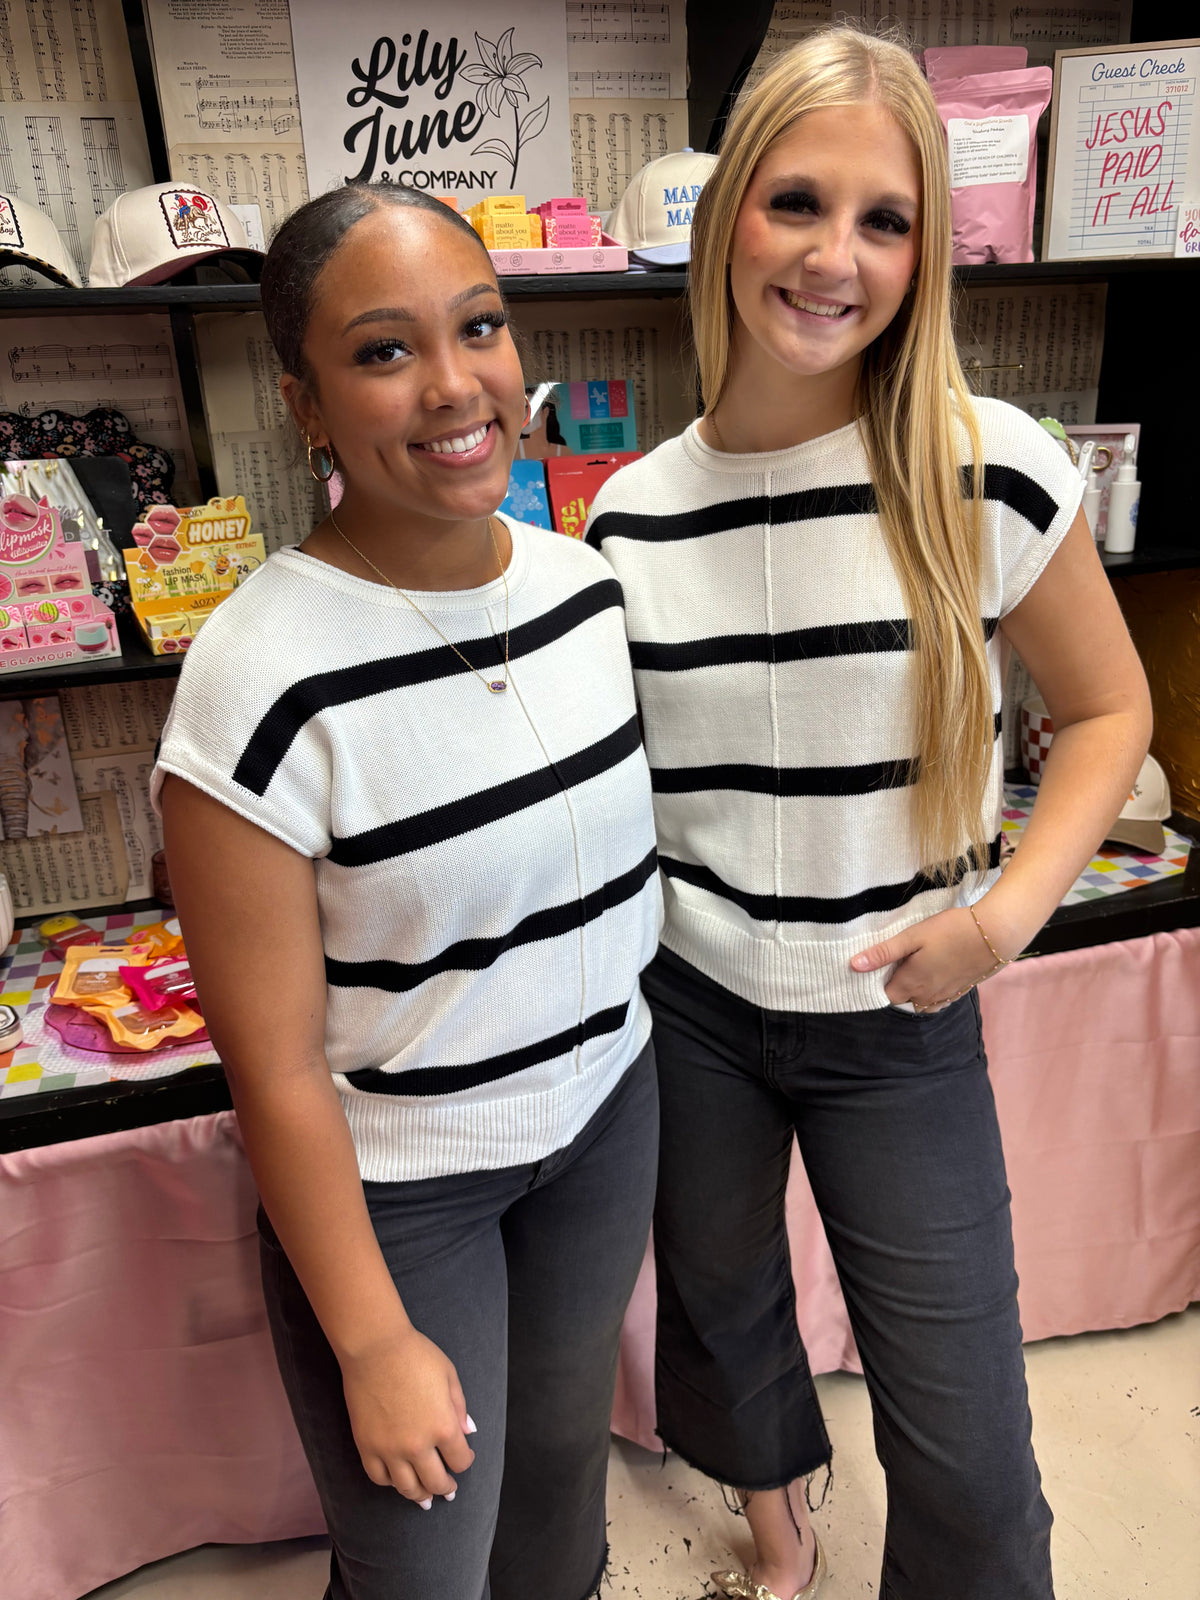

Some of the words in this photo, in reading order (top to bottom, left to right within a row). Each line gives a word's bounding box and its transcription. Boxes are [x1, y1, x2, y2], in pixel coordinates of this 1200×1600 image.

[347, 29, 467, 109] Lily
[1091, 62, 1136, 82] Guest
[1140, 58, 1185, 78] Check
[1165, 85, 1189, 93] 371012
[1086, 101, 1172, 149] JESUS
[343, 101, 484, 184] June
[1100, 144, 1162, 188] PAID
[381, 171, 393, 184] &
[398, 170, 498, 189] COMPANY
[663, 185, 702, 205] MAR
[1092, 192, 1121, 227] IT
[1128, 180, 1174, 219] ALL
[667, 207, 694, 227] MA
[0, 519, 53, 551] lipmask
[188, 519, 246, 543] HONEY
[162, 567, 191, 576] fashion
[164, 577, 178, 586] LIP
[181, 573, 206, 583] MASK
[237, 564, 249, 575] 24
[10, 650, 73, 666] GLAMOUR
